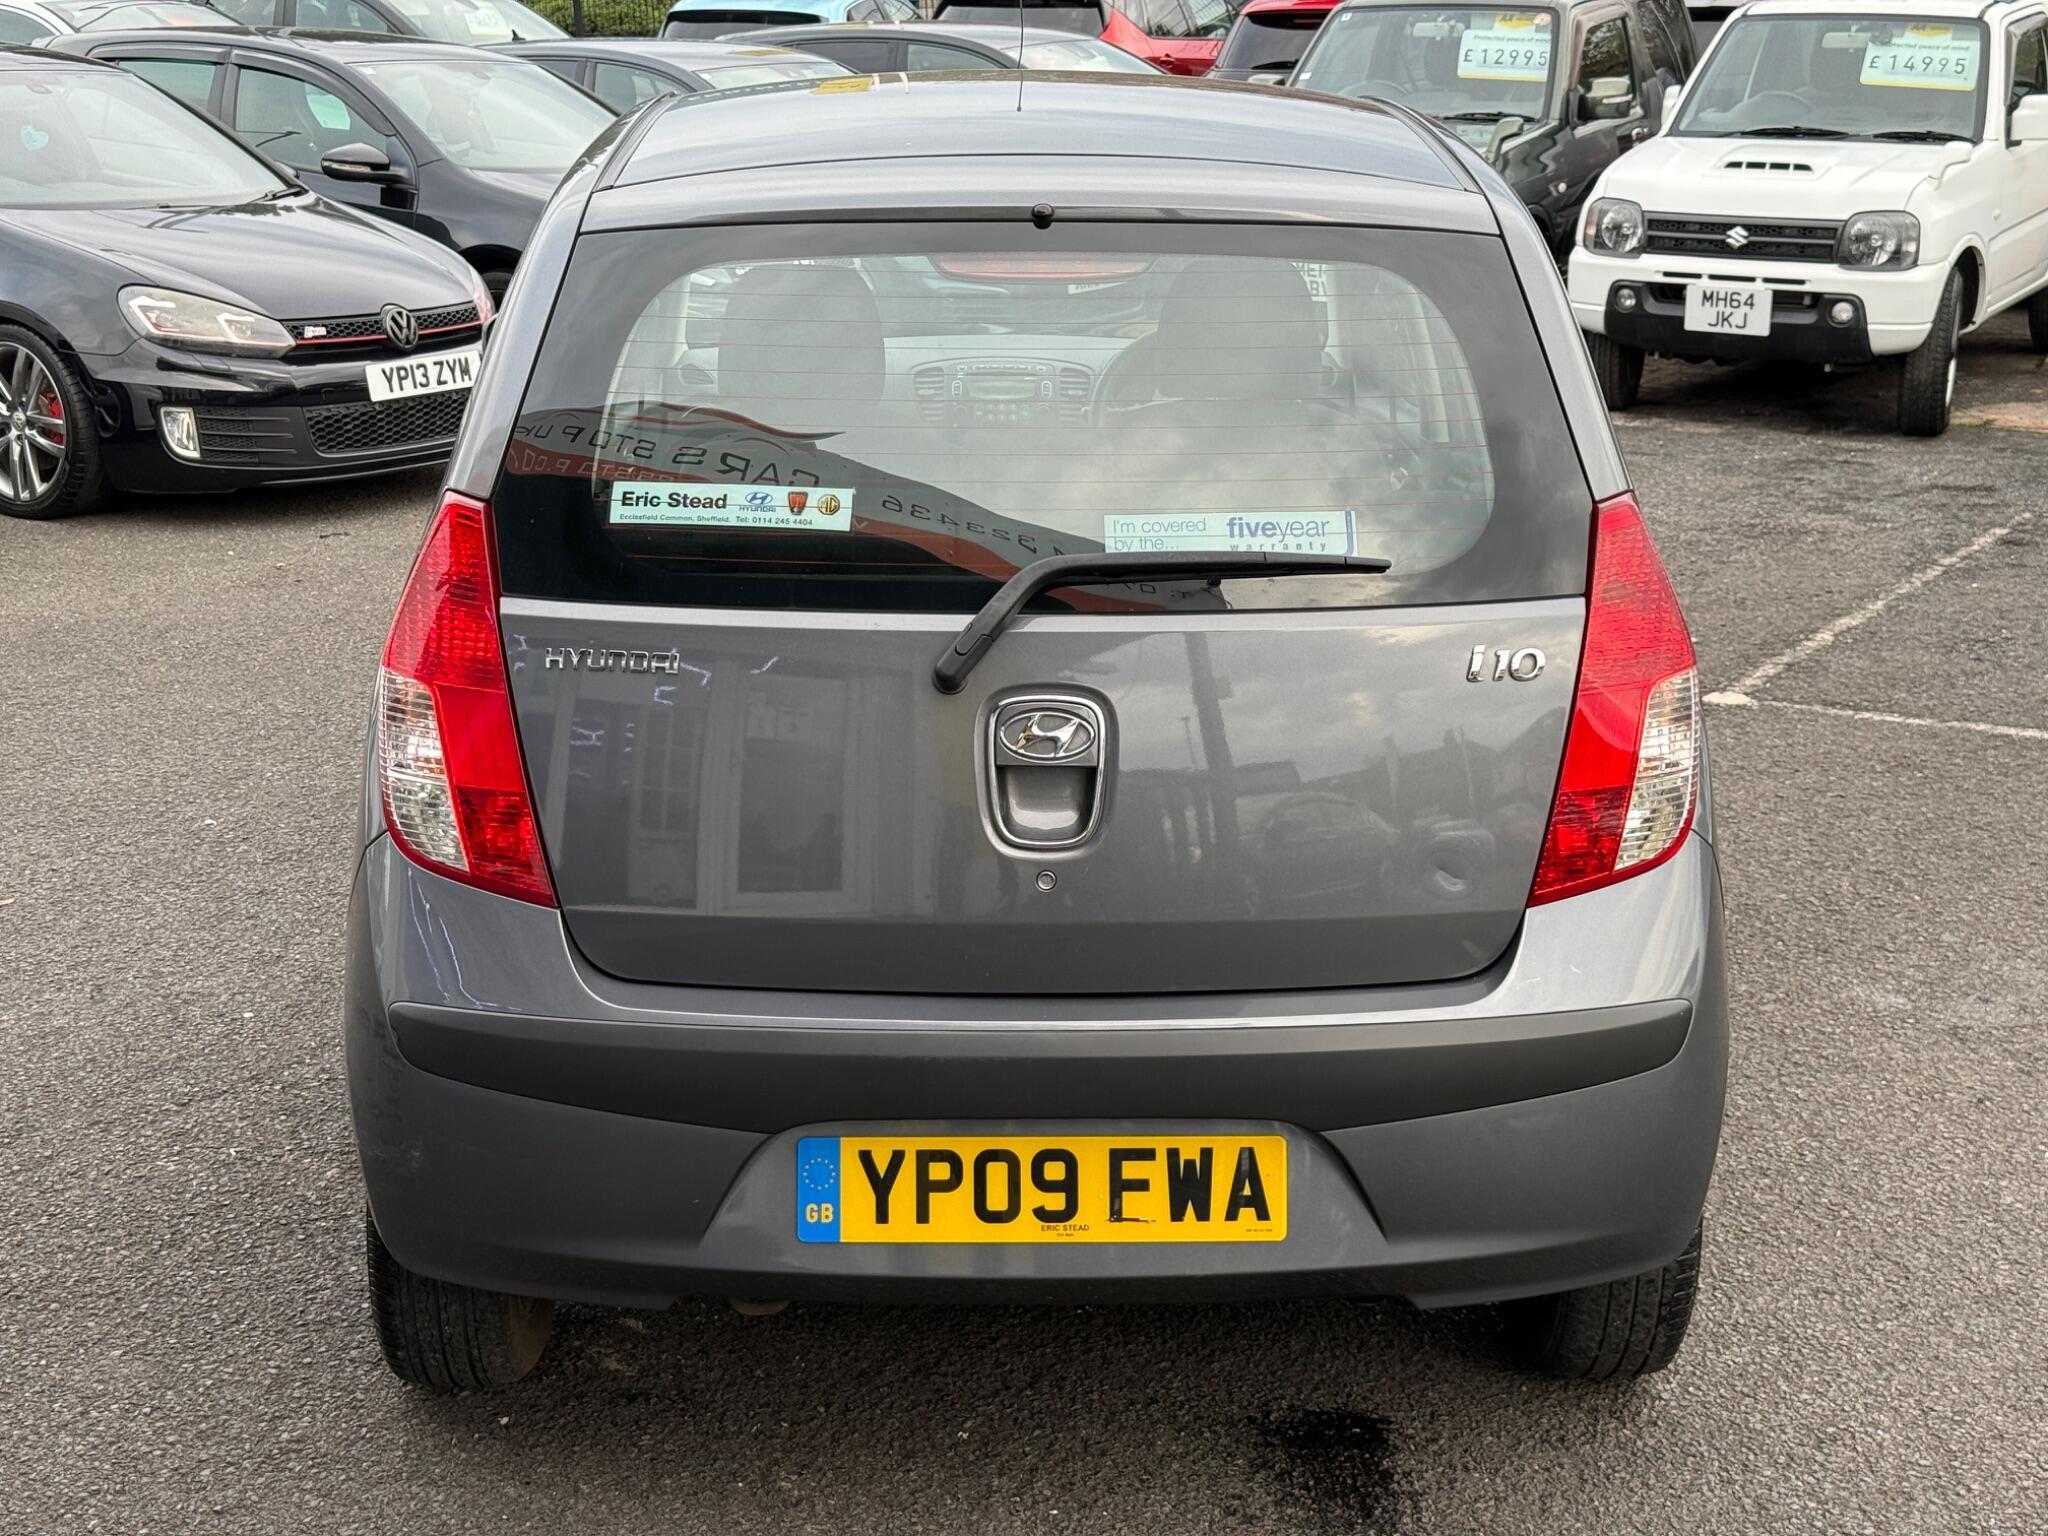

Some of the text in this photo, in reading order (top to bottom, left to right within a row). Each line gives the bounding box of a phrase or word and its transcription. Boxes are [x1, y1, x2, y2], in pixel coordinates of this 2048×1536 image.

[1701, 289, 1756, 310] MH64
[1707, 310, 1748, 329] JKJ
[381, 356, 472, 393] YP13 ZYM
[621, 490, 728, 509] Eric Stead
[752, 516, 773, 524] 0114
[1113, 517, 1207, 534] I'm covered
[1226, 516, 1331, 543] fiveyear
[1113, 536, 1134, 552] by
[1229, 541, 1327, 552] warranty
[544, 646, 681, 675] HYUNDAI
[1466, 644, 1547, 683] i10
[858, 1146, 1271, 1224] YP09 FWA
[804, 1202, 835, 1224] GB
[1041, 1224, 1090, 1232] ERIC STEAD
